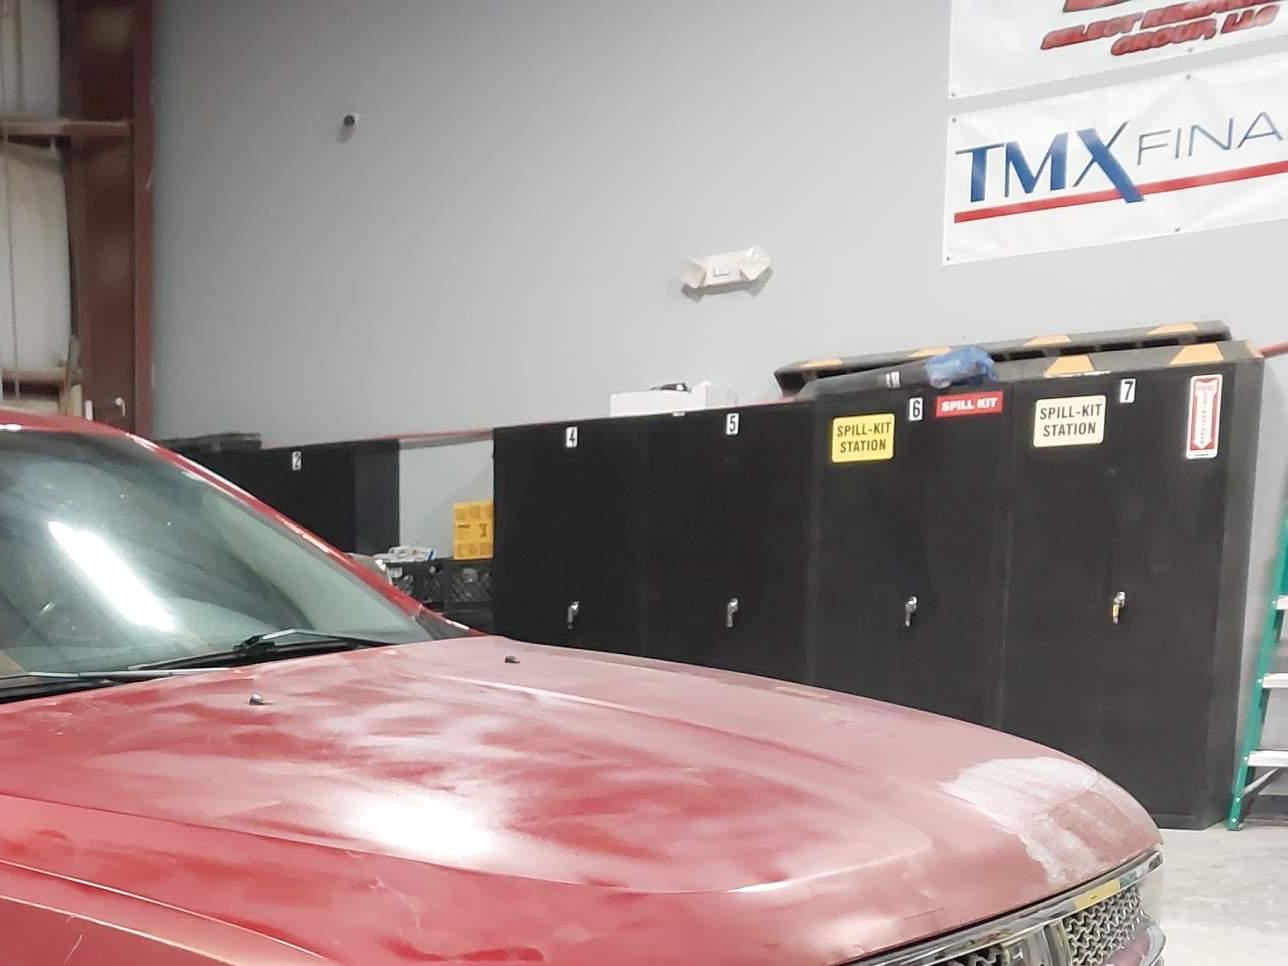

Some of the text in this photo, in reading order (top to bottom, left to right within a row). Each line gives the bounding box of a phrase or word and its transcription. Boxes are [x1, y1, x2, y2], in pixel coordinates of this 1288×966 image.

[955, 121, 1145, 203] TMX
[1124, 381, 1134, 401] 7
[912, 400, 921, 418] 6
[941, 397, 998, 412] SPILL KIT
[1040, 403, 1103, 421] SPILL-KIT
[728, 415, 736, 433] 5
[837, 421, 892, 438] SPILL-KIT
[1043, 422, 1097, 438] STATION
[568, 428, 576, 447] 4
[840, 438, 887, 454] STATION
